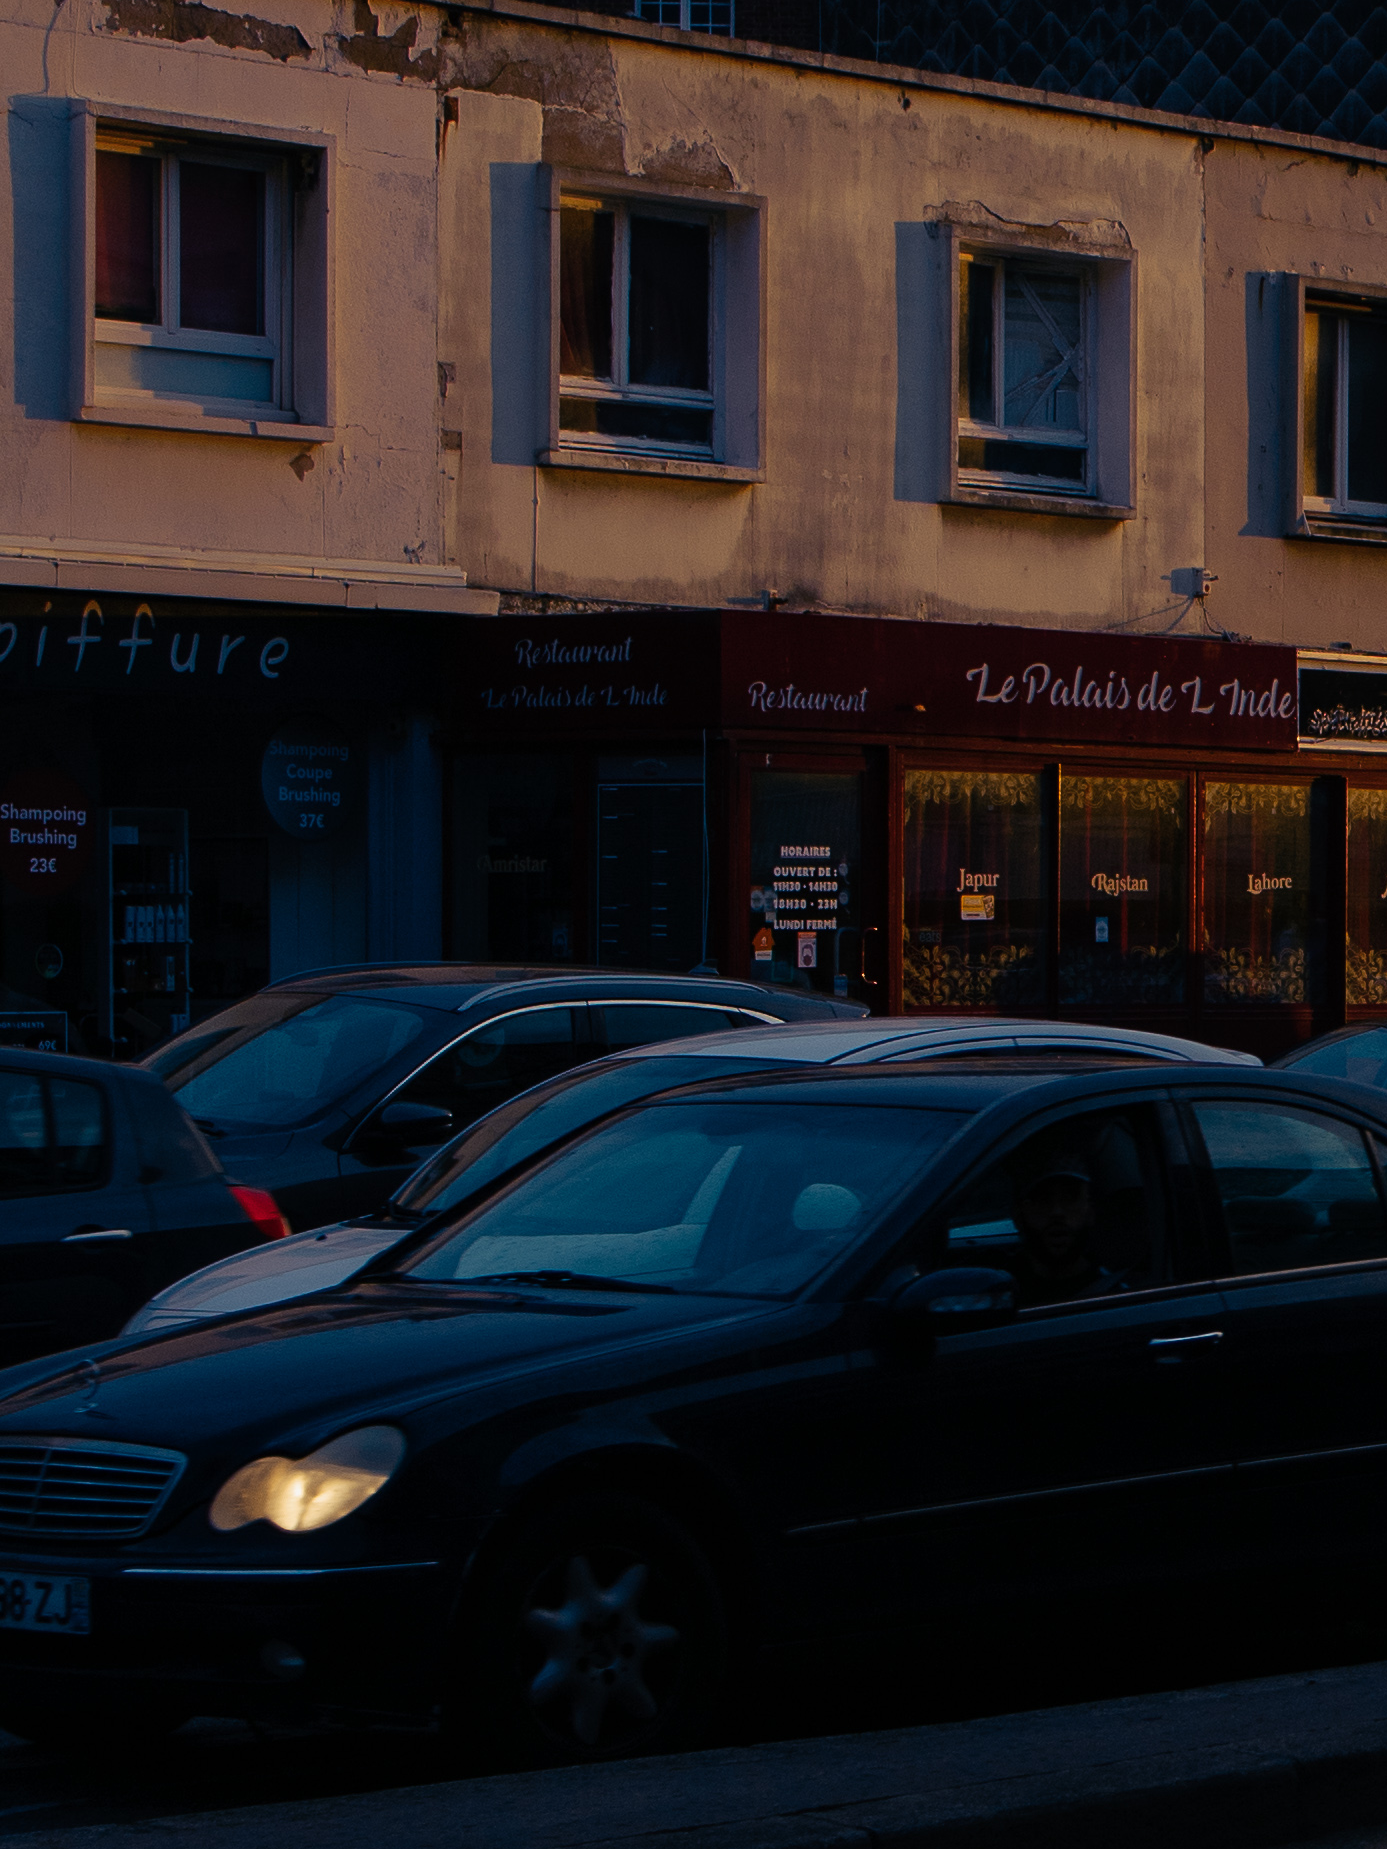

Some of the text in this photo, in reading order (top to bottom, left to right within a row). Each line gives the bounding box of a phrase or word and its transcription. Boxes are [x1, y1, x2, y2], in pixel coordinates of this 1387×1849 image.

[515, 636, 633, 668] Restaurant
[481, 687, 508, 709] Le
[511, 684, 572, 709] Palais
[574, 684, 597, 707] de
[747, 680, 868, 713] Restaurant
[965, 662, 1020, 704] Le
[1021, 662, 1131, 709] Palais
[1138, 670, 1175, 712] de
[269, 739, 350, 762] Shampoing
[286, 763, 333, 784] Coupe
[279, 785, 341, 807] Brushing
[0, 802, 87, 826] Shampoing
[300, 813, 326, 829] 37€
[10, 828, 78, 850] Brushing
[780, 845, 831, 857] HORAIRES
[30, 857, 57, 873] 23€
[477, 854, 548, 874] Amristar
[773, 865, 816, 878] OUVERT
[818, 866, 832, 877] DE
[957, 868, 1000, 892] Japur
[1091, 873, 1149, 896] Rajstan
[1247, 873, 1293, 895] Lahore
[774, 917, 838, 930] LUNDI FERMÉ
